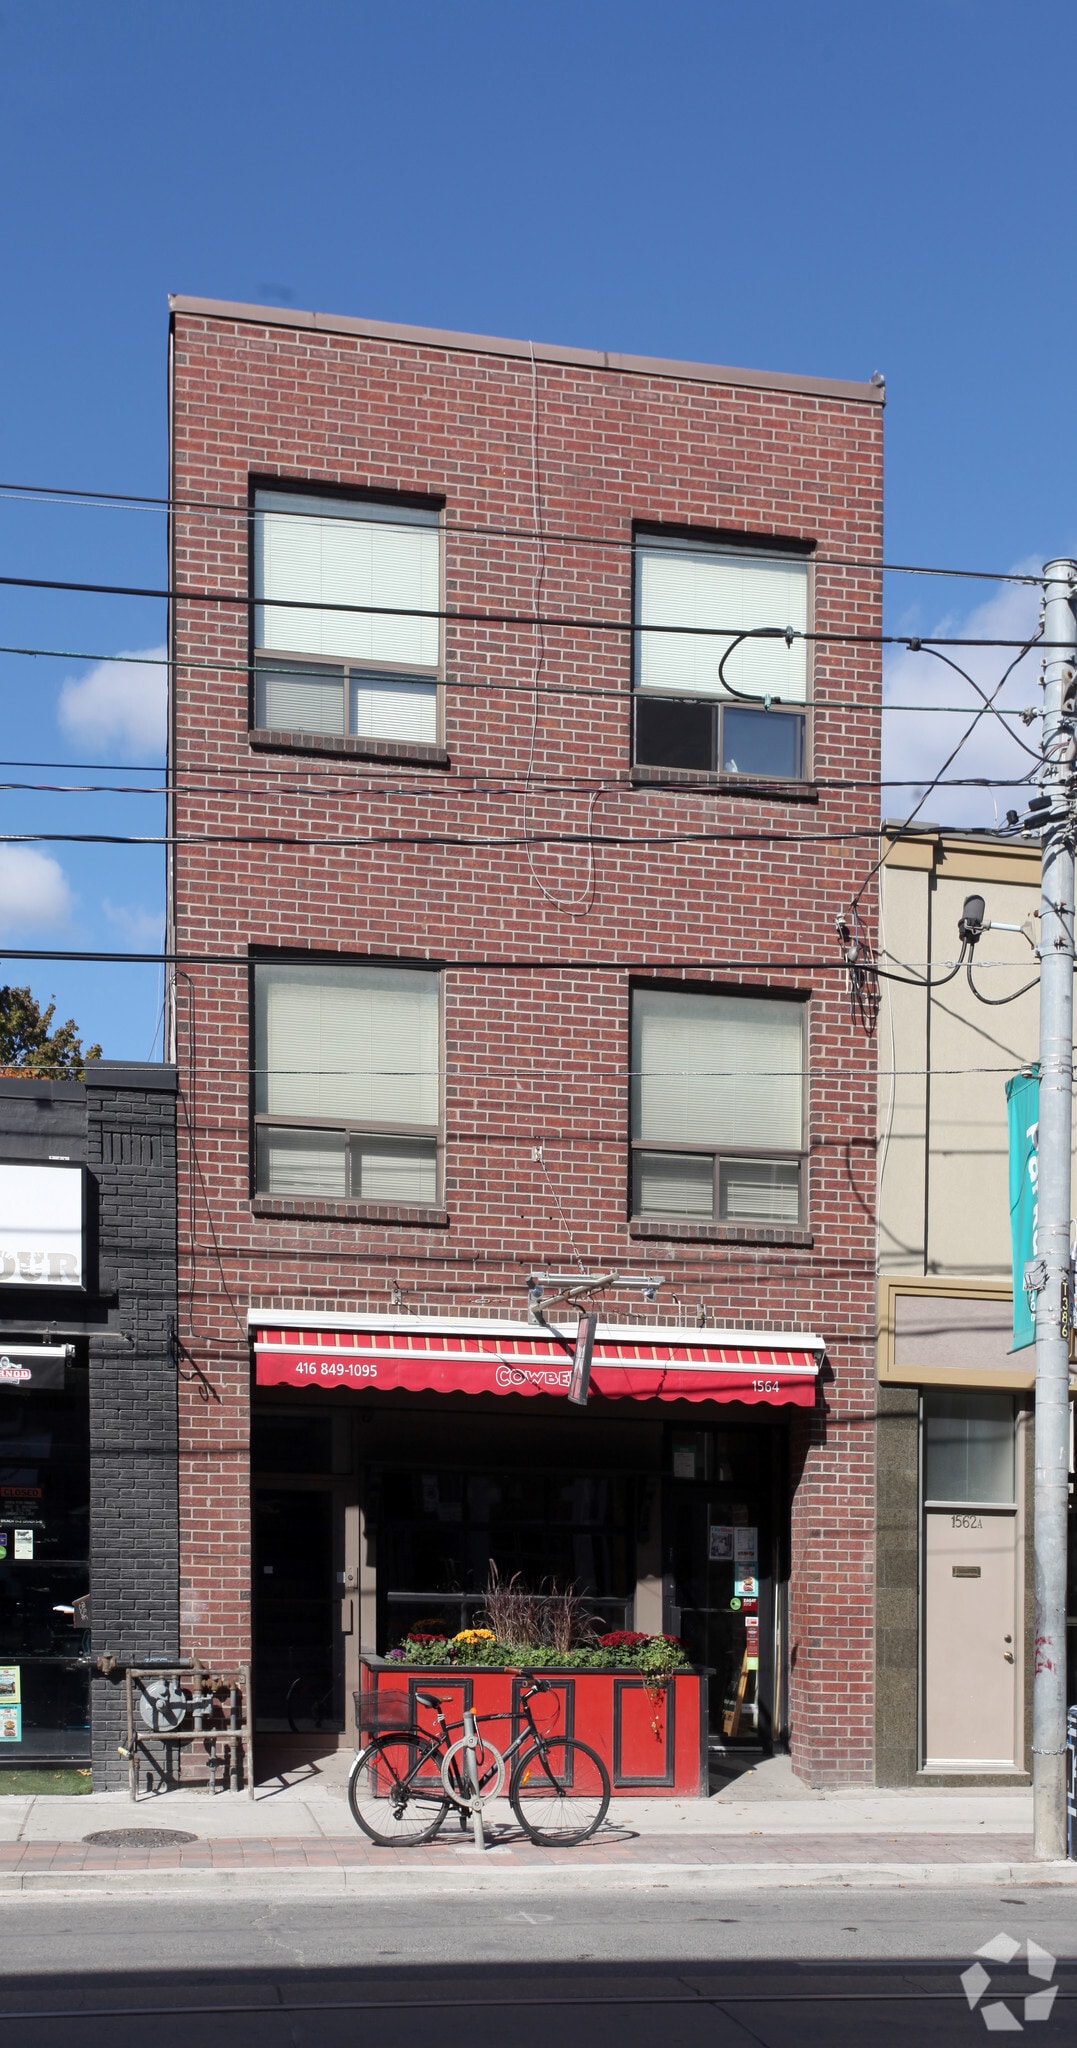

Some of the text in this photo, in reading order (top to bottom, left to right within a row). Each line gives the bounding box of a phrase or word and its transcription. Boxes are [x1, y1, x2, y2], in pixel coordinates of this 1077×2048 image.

[1061, 1282, 1069, 1337] T386
[295, 1361, 378, 1378] 416 849-1095
[495, 1365, 573, 1387] COWBE
[752, 1380, 780, 1393] 1564
[4, 1488, 39, 1496] CLOSED
[951, 1514, 983, 1529] 1562A
